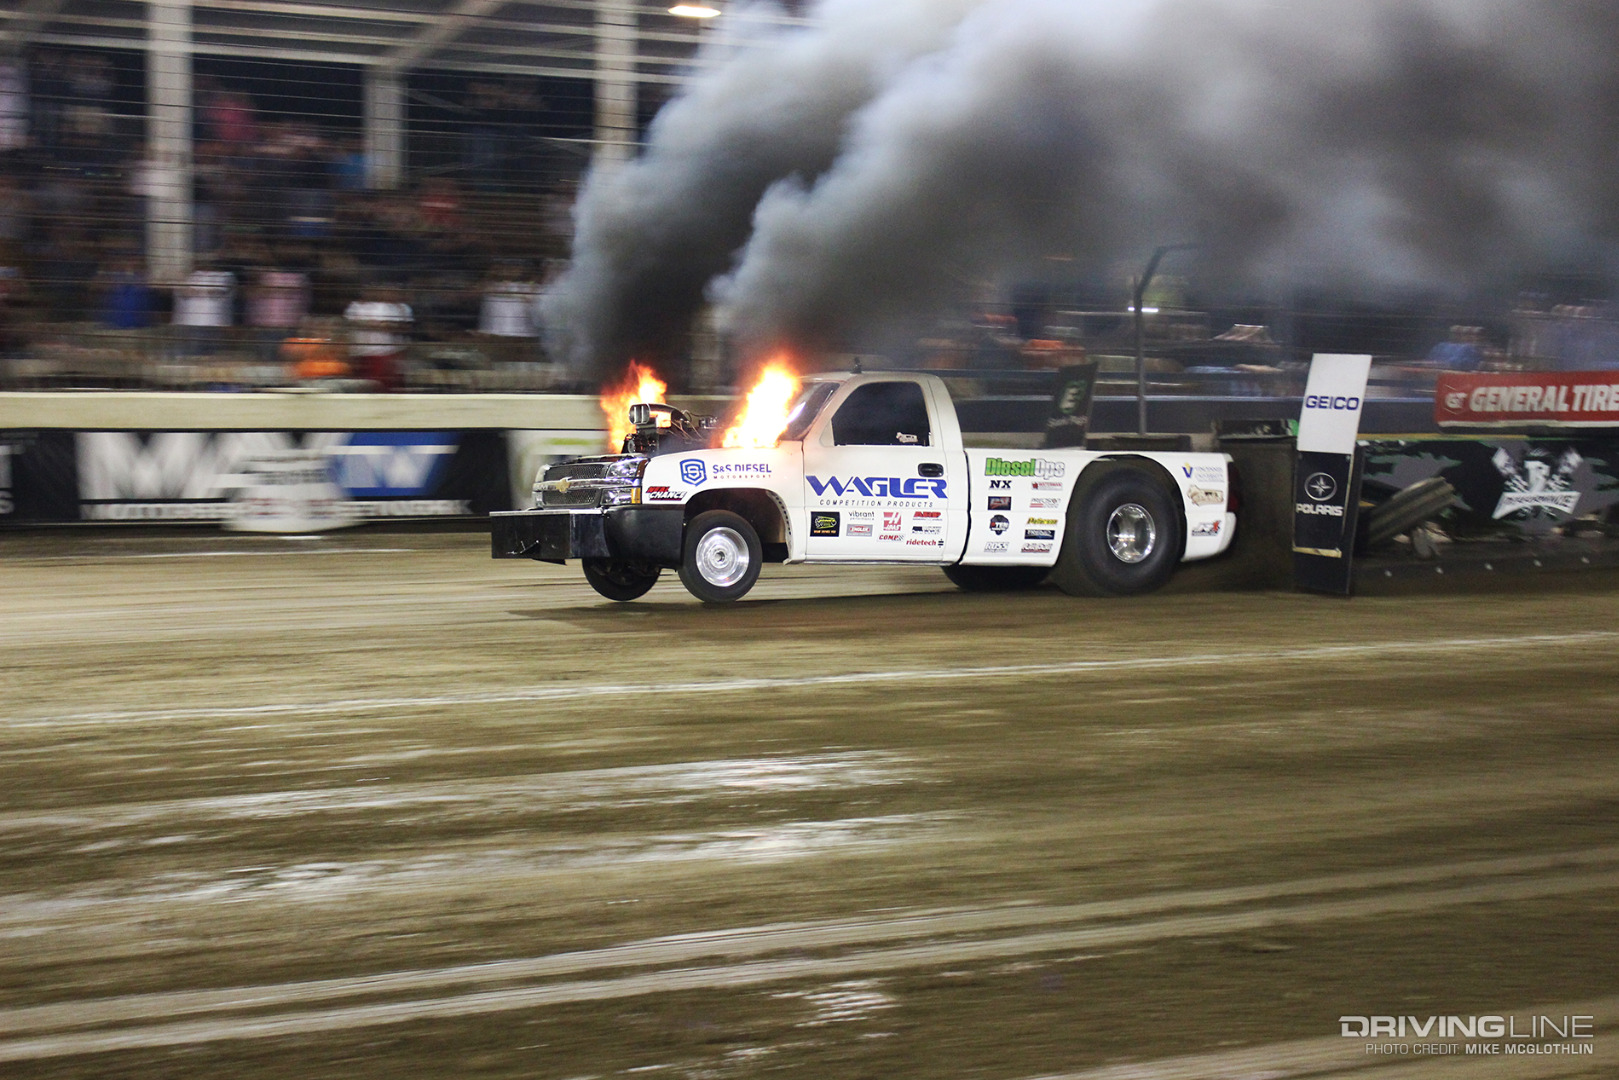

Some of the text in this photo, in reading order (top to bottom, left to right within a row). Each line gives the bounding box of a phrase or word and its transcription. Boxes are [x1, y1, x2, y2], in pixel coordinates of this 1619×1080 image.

[1305, 395, 1360, 411] GEICO
[1469, 384, 1619, 412] GENERAL TIRE
[712, 463, 772, 474] S&S DIESEL
[985, 457, 1065, 480] DieselOps
[805, 475, 948, 499] WAGLER
[989, 480, 1012, 488] NX
[649, 491, 687, 499] CHANCE
[819, 499, 934, 508] COMPETITION PRODUCTS
[1295, 503, 1343, 517] POLARIS
